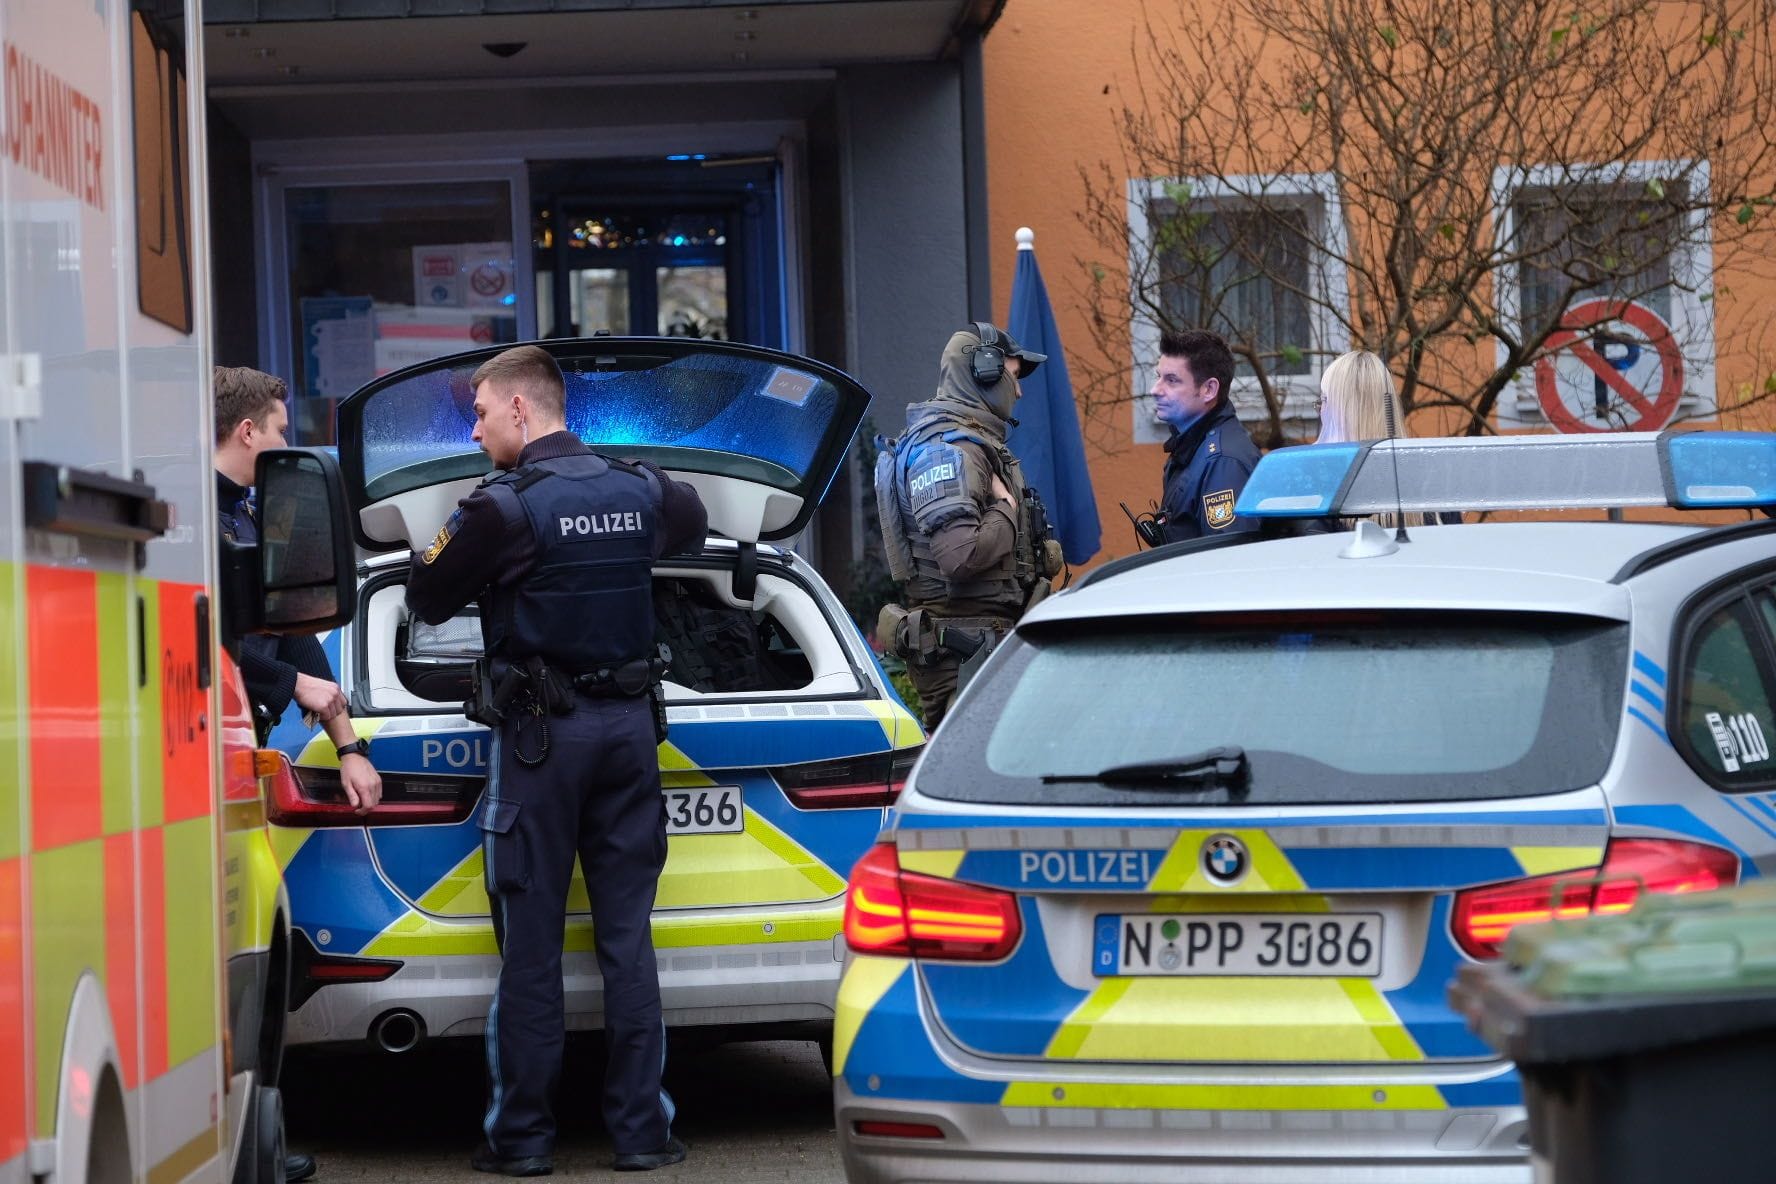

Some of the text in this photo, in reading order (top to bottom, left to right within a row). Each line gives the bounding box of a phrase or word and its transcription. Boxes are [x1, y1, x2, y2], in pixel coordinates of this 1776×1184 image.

[911, 463, 954, 496] POLIZEI
[1206, 493, 1231, 505] POLIZEI
[560, 512, 642, 536] POLIZEI
[1729, 712, 1769, 763] 110
[662, 792, 737, 828] 366
[1020, 851, 1150, 883] POLIZEI
[1101, 921, 1372, 967] D N PP 3086
